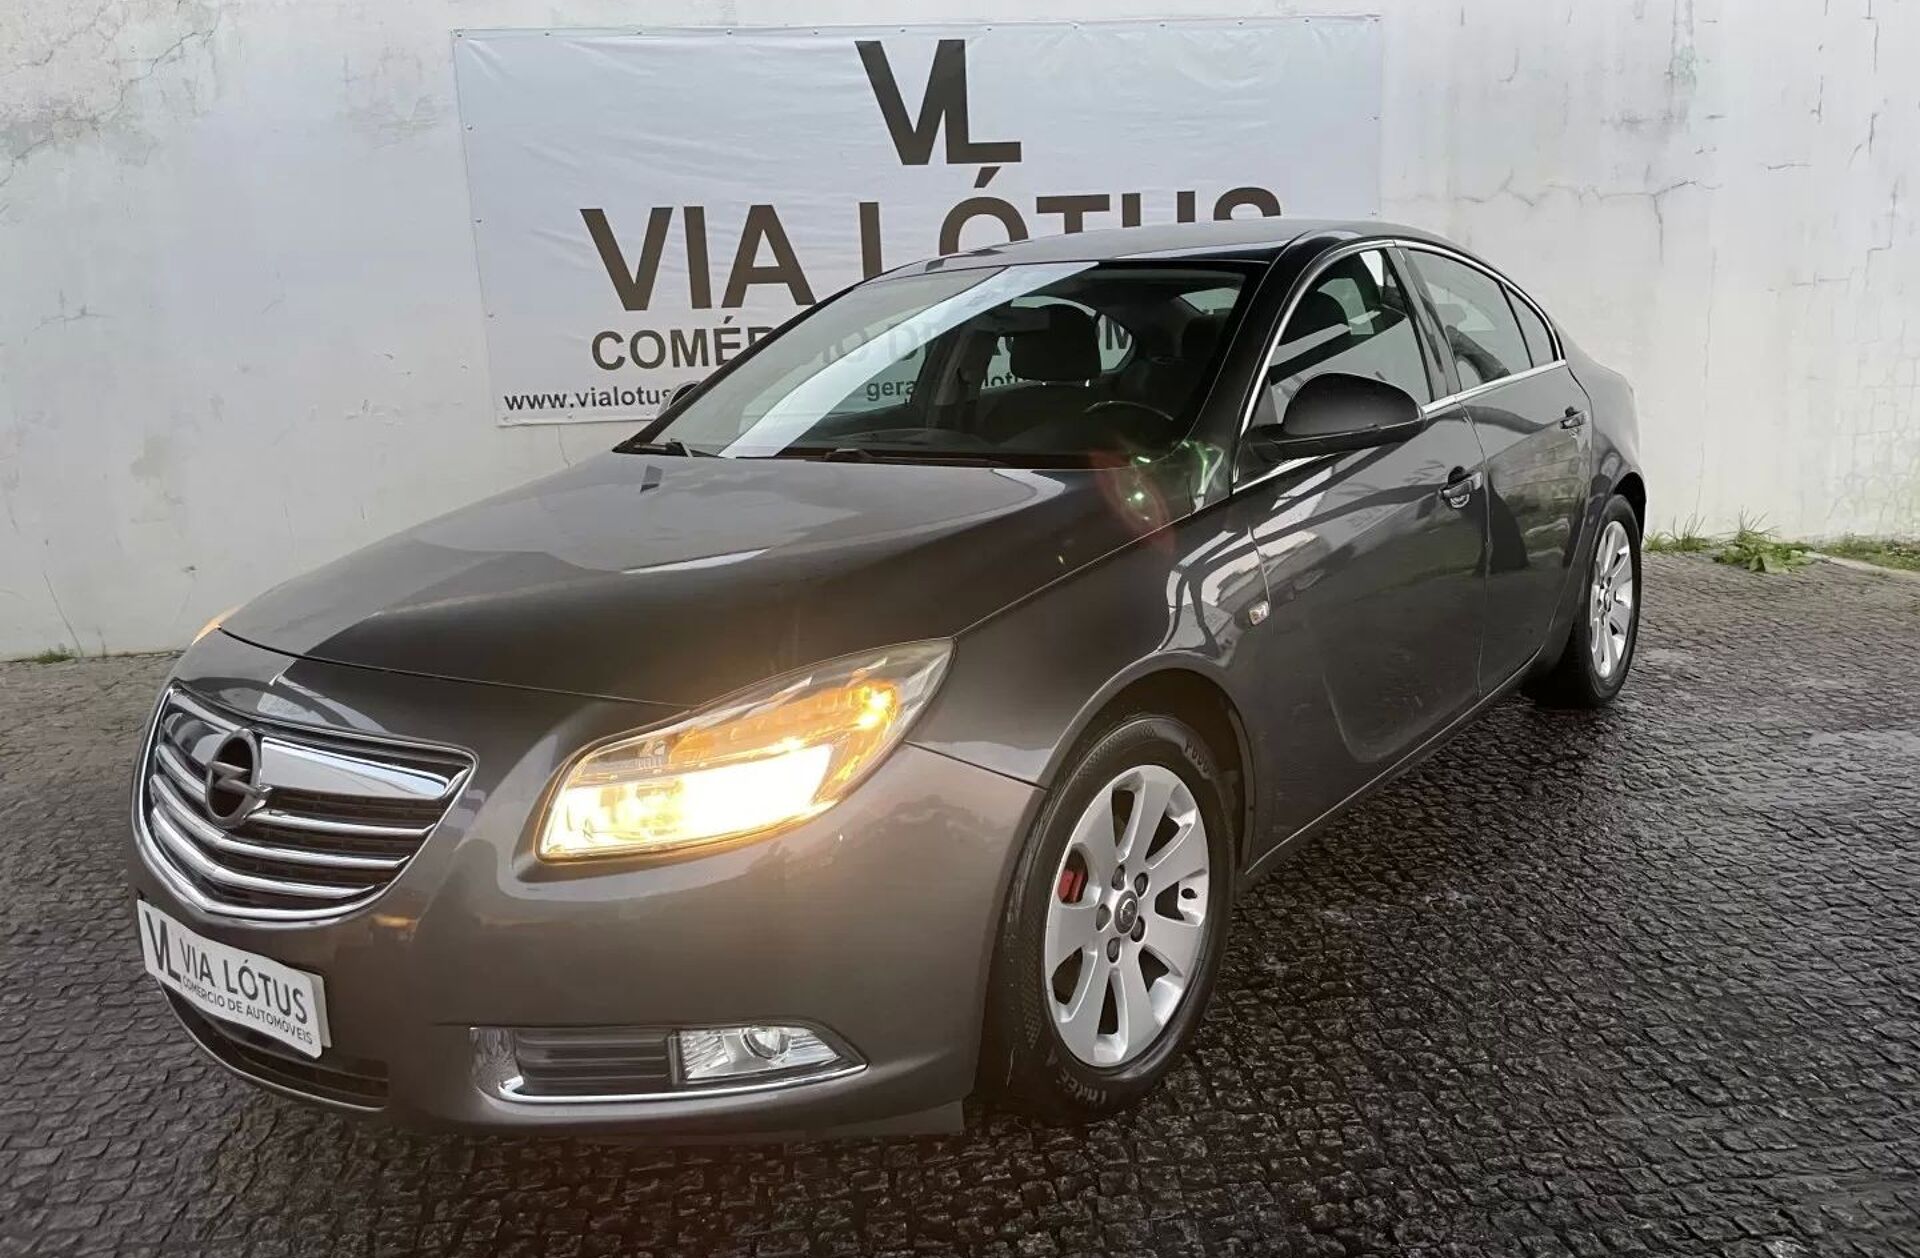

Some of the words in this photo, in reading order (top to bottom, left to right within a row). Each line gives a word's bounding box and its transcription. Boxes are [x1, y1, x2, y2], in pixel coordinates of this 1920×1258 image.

[855, 39, 1022, 166] VL
[579, 203, 817, 312] VIA
[859, 166, 1282, 282] LÓT
[144, 911, 182, 984] VL
[179, 937, 216, 988] VIA
[223, 958, 308, 1025] LÓTUS
[227, 998, 243, 1013] DE
